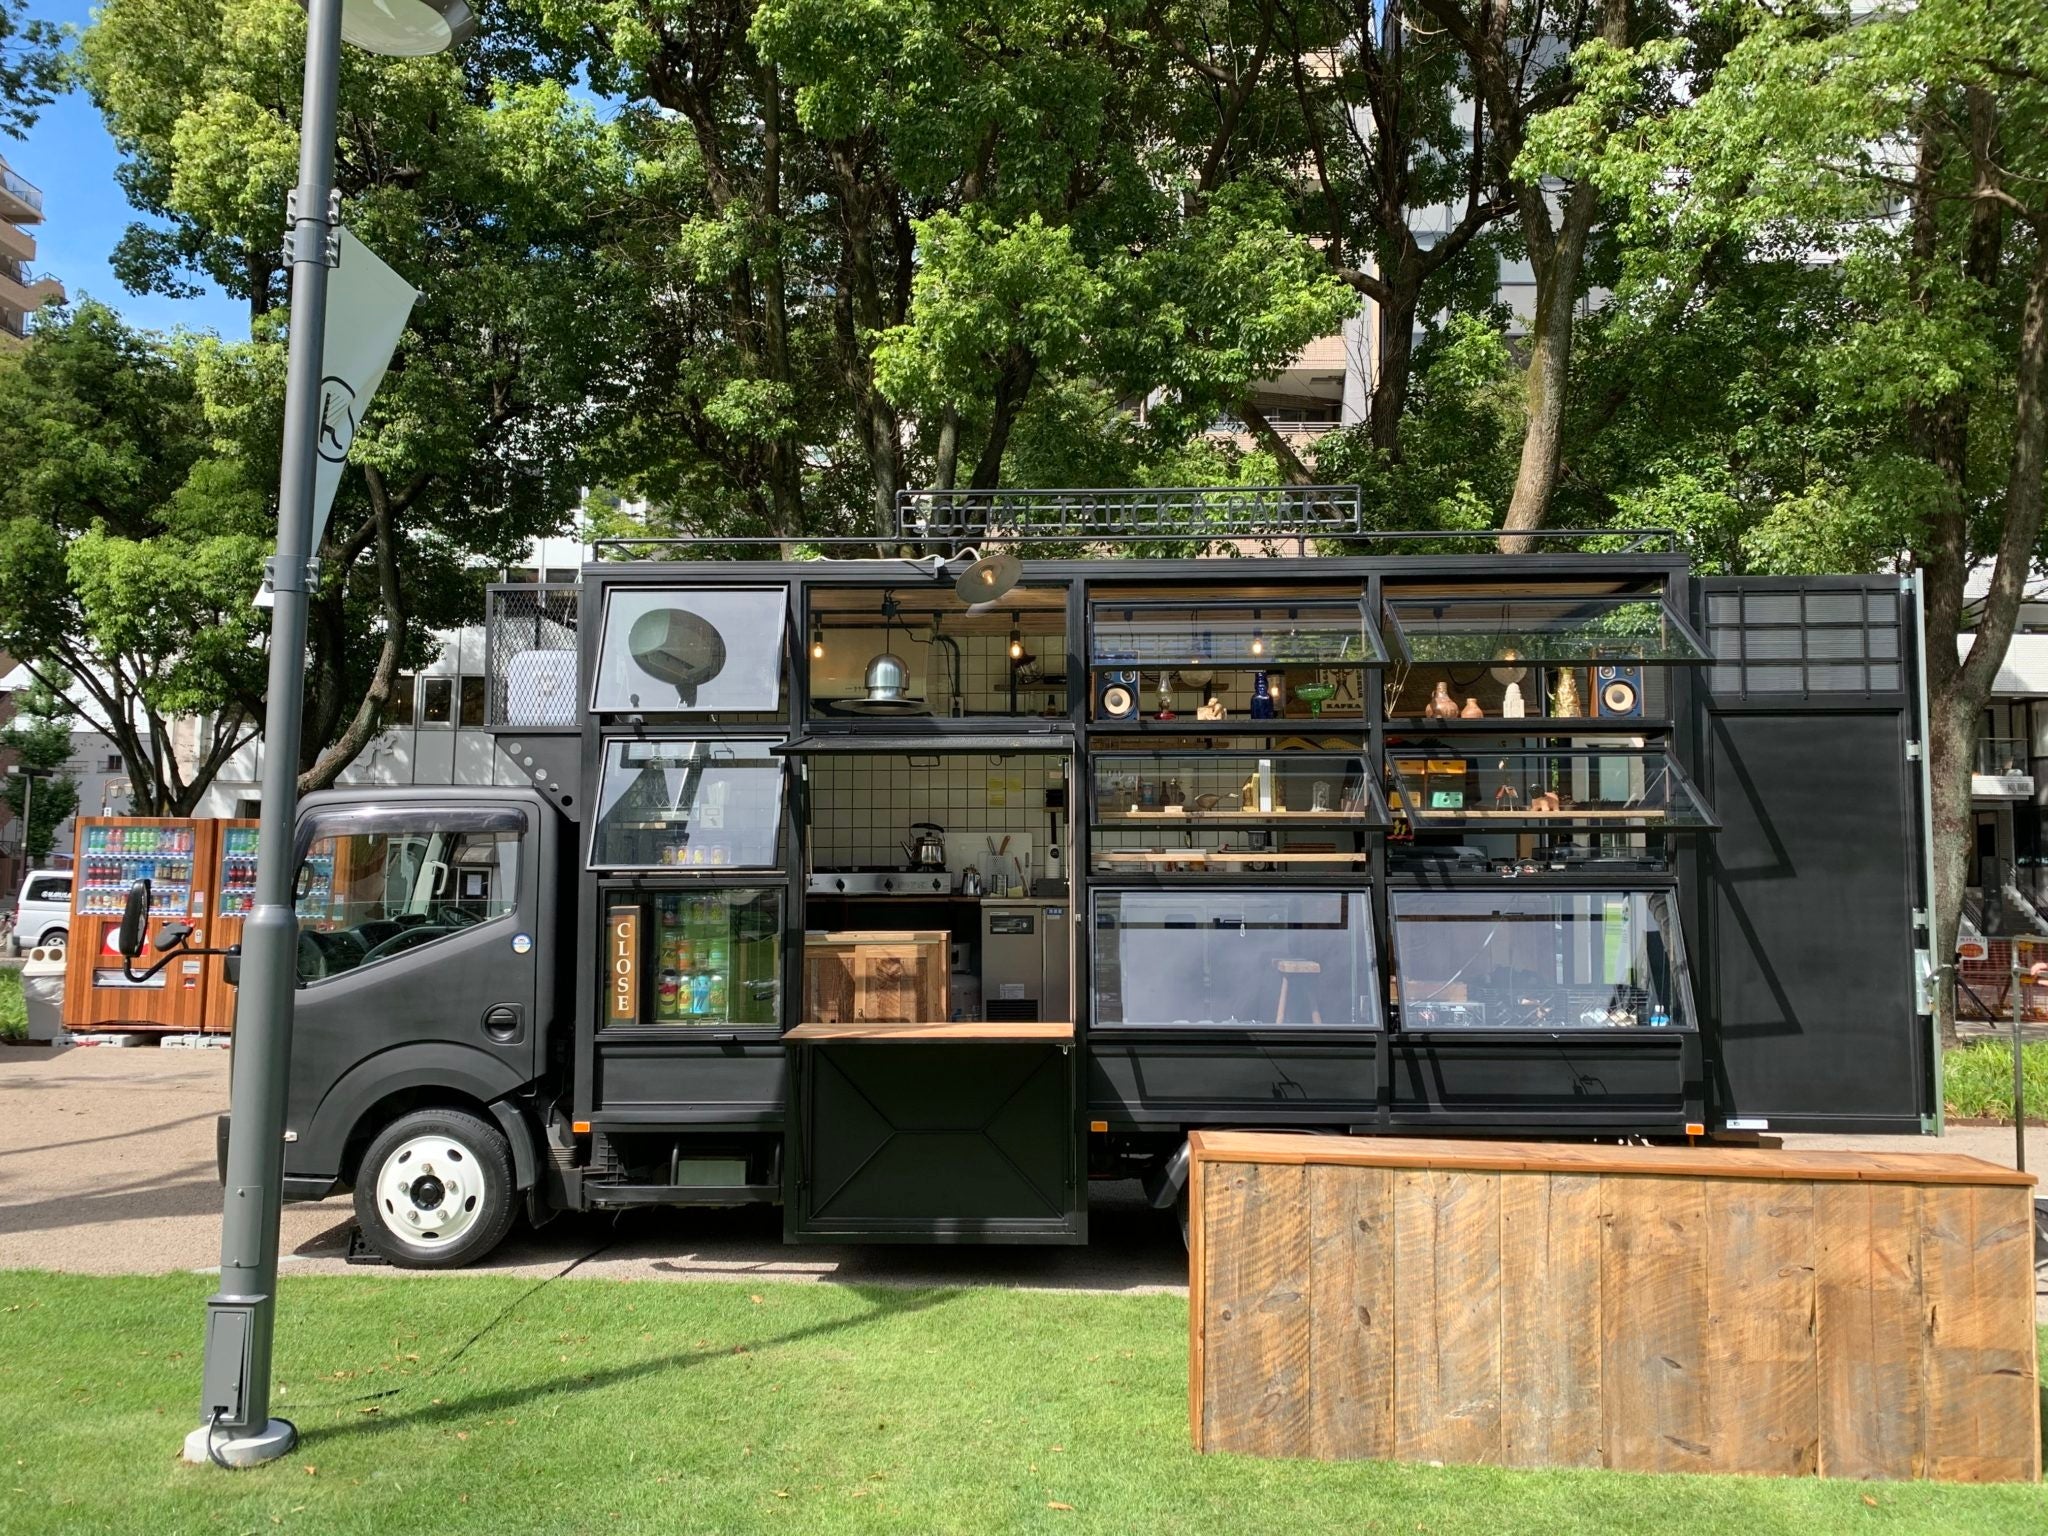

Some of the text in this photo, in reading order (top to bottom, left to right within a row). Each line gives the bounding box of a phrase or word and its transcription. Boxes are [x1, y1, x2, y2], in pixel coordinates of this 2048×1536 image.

[911, 493, 1345, 534] SOCIAL TRUCK & PARKS
[616, 922, 631, 1011] CLOSE
